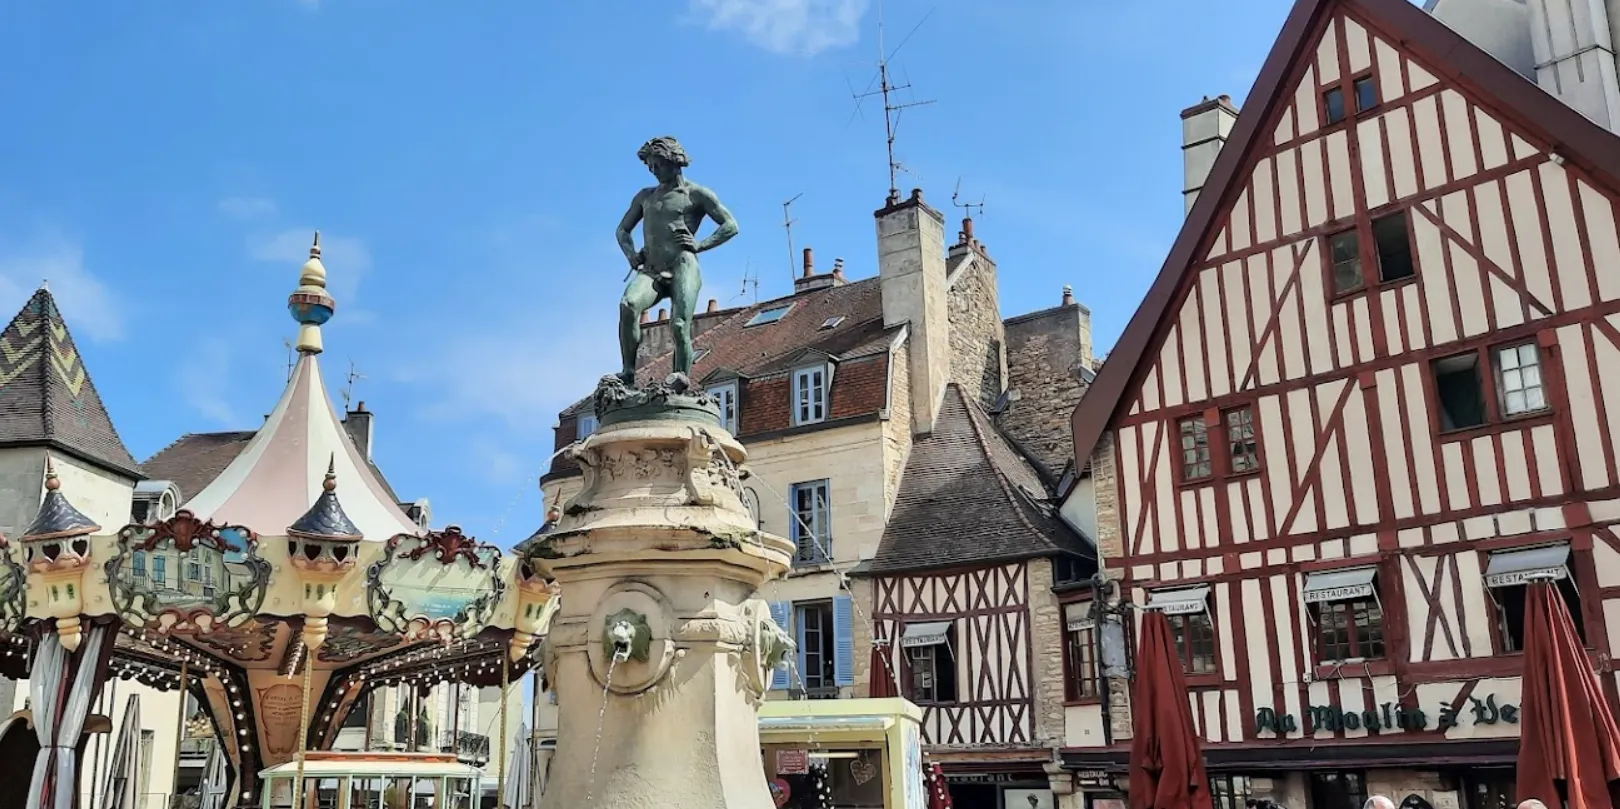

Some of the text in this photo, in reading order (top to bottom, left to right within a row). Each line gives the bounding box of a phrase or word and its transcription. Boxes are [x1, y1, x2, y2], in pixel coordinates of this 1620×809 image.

[1309, 586, 1366, 600] RESTAURANT
[1256, 693, 1519, 733] Au Moulin à Ve
